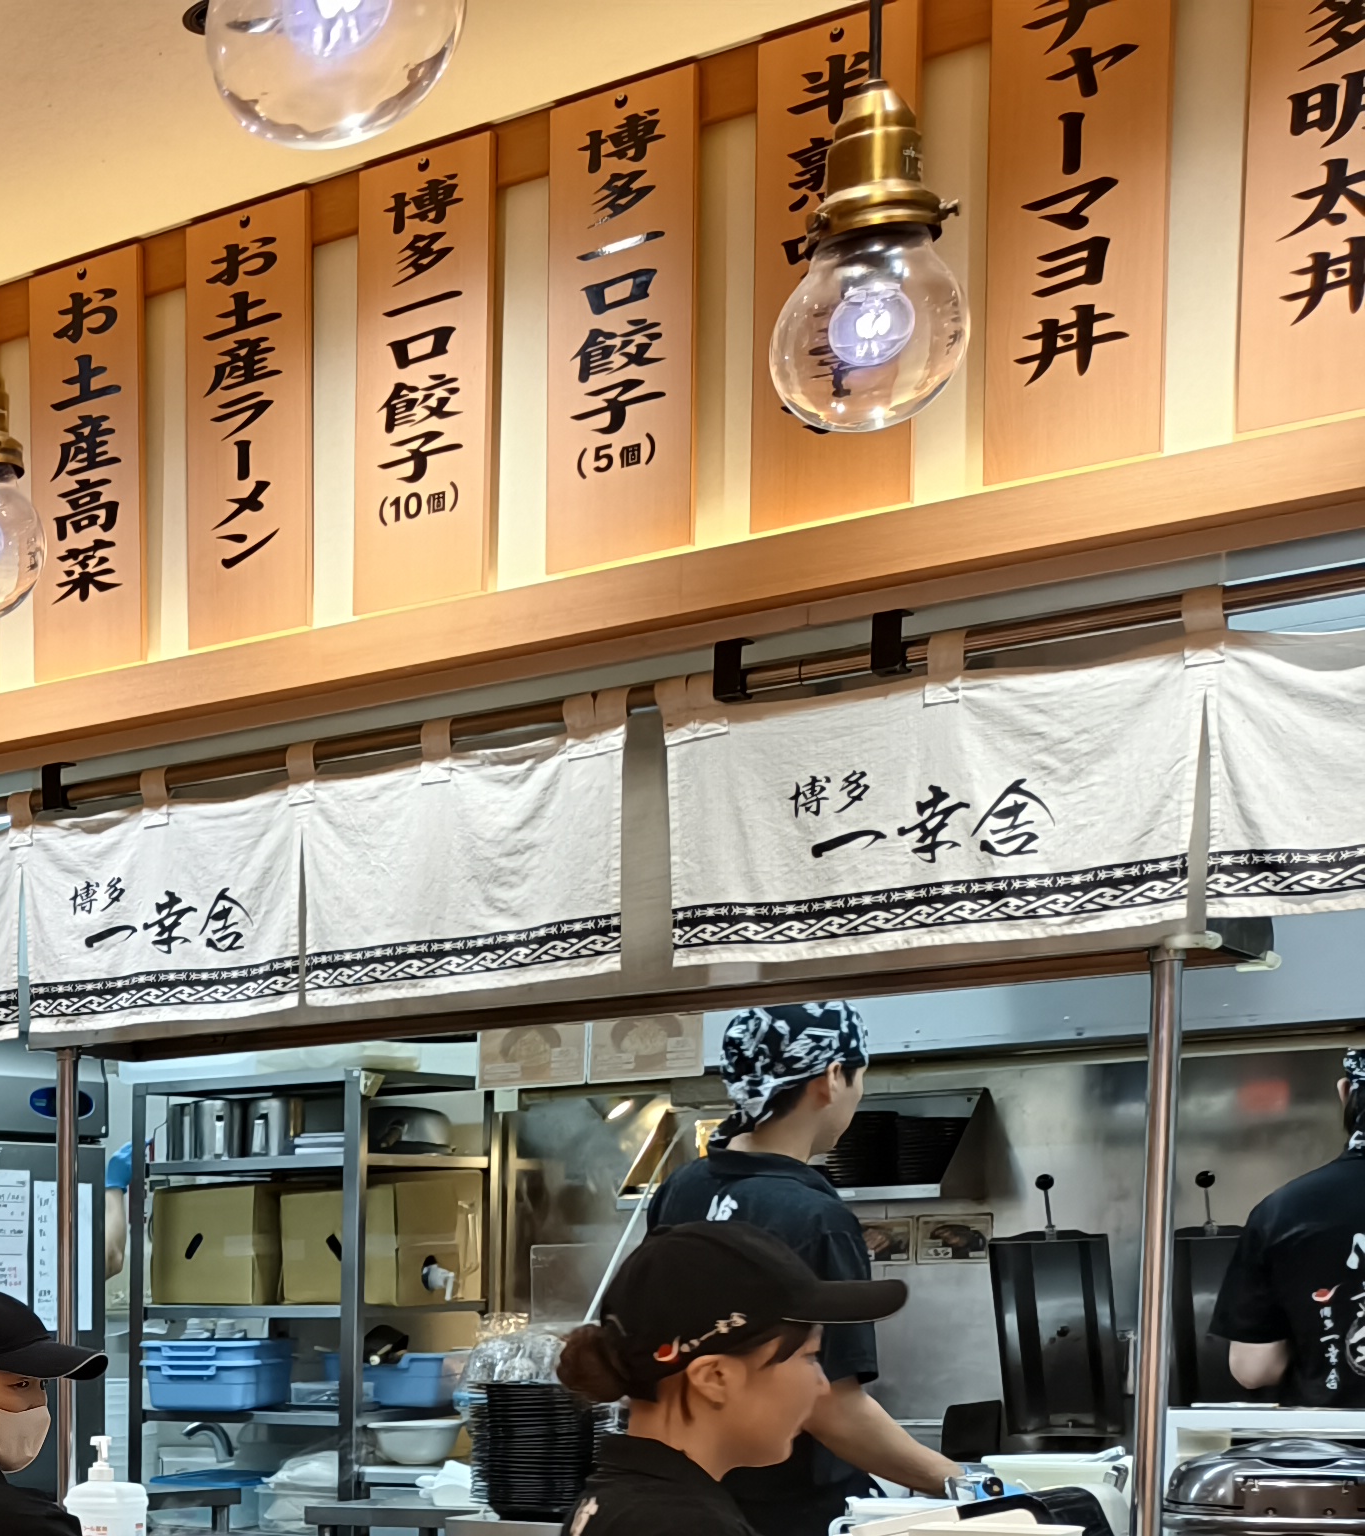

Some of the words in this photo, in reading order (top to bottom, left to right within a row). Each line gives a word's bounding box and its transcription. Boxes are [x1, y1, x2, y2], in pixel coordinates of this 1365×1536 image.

[203, 236, 282, 570] お土産ラーメン
[377, 174, 463, 483] 博多一口餃子
[570, 108, 666, 435] 博多一口餃子
[49, 287, 122, 605] お土産高菜
[69, 876, 125, 916] 博多
[788, 770, 871, 818] 博多
